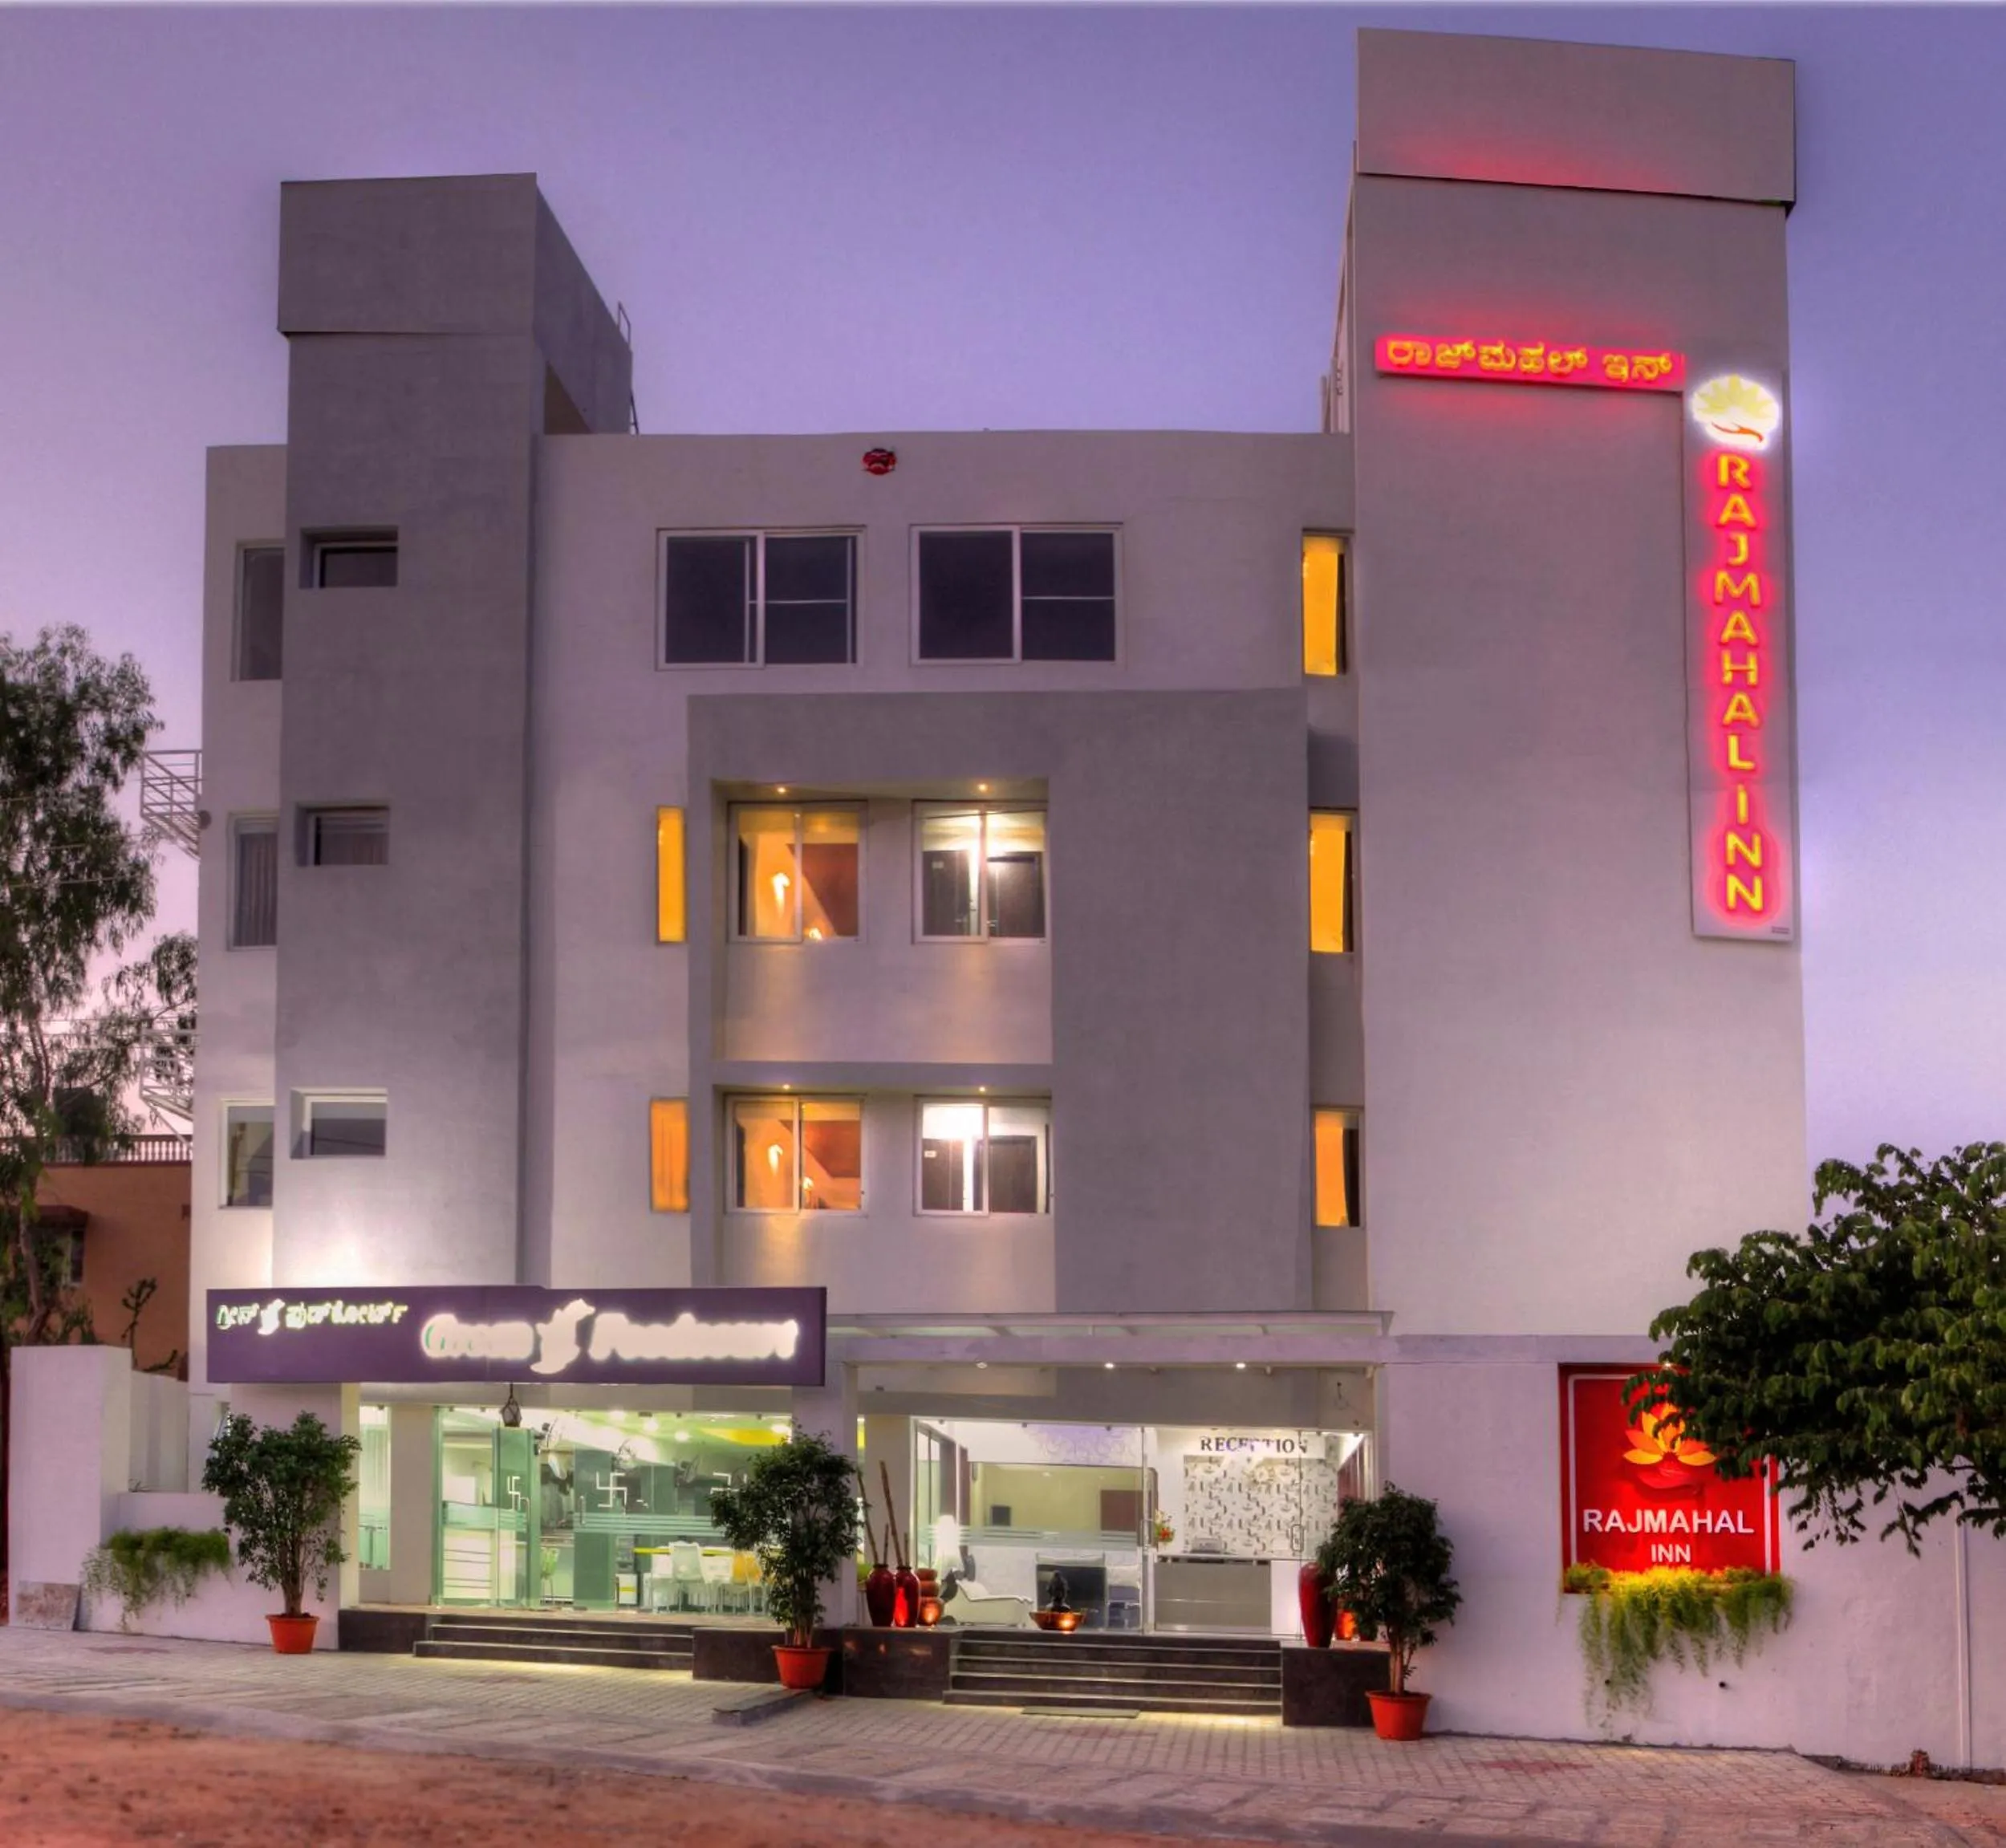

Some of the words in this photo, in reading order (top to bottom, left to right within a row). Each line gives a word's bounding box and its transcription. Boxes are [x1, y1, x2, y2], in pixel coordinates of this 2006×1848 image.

[1603, 352, 1673, 382] ಇನ್
[1714, 454, 1761, 770] RAJMAHAL
[1724, 783, 1763, 912] INN
[1583, 1509, 1755, 1533] RAJMAHAL
[1651, 1544, 1691, 1562] INN
